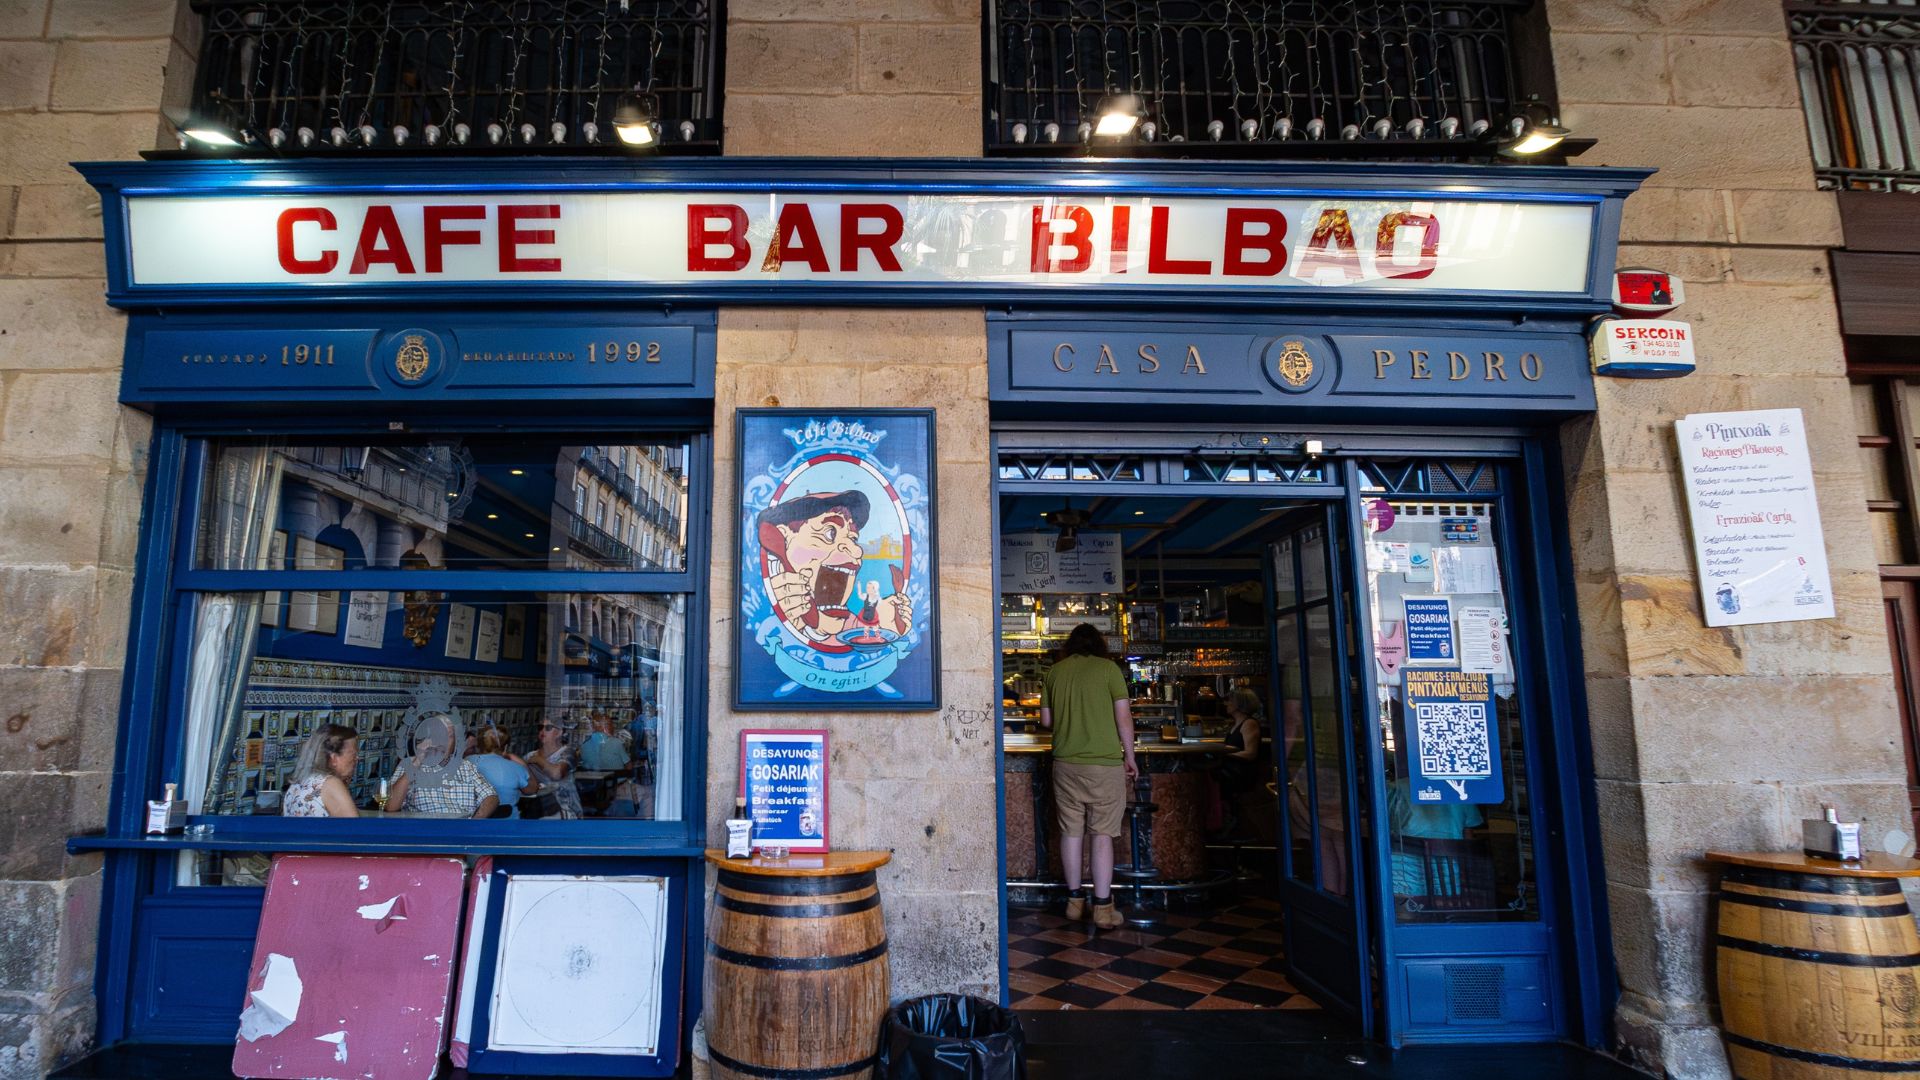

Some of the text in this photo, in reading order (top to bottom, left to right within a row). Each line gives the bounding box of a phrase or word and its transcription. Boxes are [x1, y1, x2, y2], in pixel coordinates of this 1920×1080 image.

[277, 203, 1441, 280] CAFE BAR BILBAO
[282, 344, 335, 365] 1911
[587, 341, 661, 363] 1992
[1053, 344, 1544, 381] CASA PEDRO
[794, 421, 881, 445] Café Bilbao
[1705, 422, 1772, 442] Pintxoak
[1409, 613, 1449, 623] GOSARIAK
[805, 672, 827, 685] On
[1407, 681, 1459, 697] PINTXOAK
[752, 748, 819, 759] DESAYUNOS
[752, 764, 819, 780] GOSARIAK
[752, 784, 818, 795] Petit déjeuner
[752, 796, 818, 805] Breakfast
